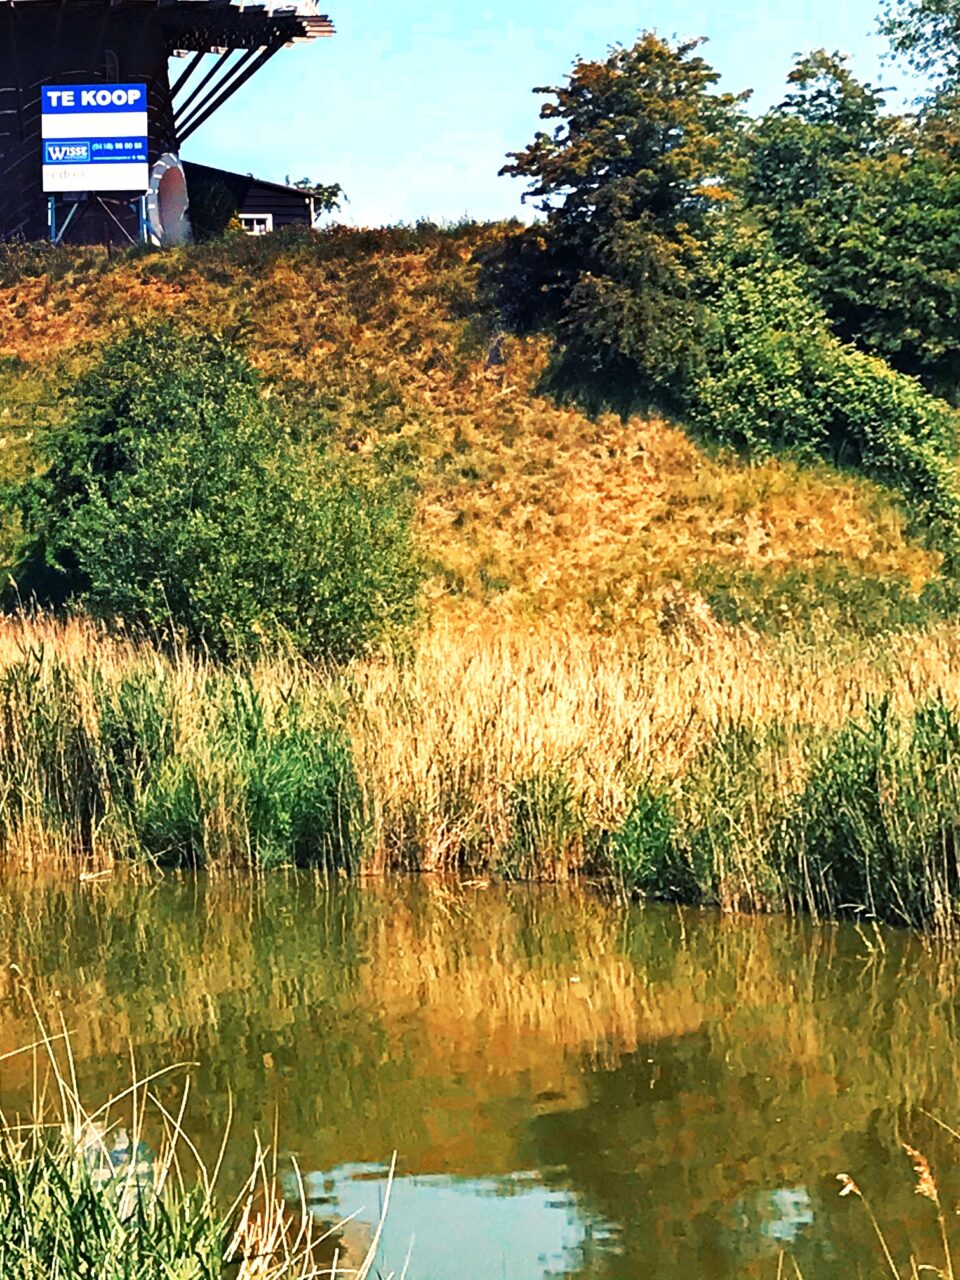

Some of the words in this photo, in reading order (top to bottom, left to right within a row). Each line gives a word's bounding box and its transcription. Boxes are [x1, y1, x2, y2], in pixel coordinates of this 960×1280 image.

[46, 91, 75, 107] TE
[81, 89, 141, 106] KOOP
[48, 146, 88, 160] WISSE
